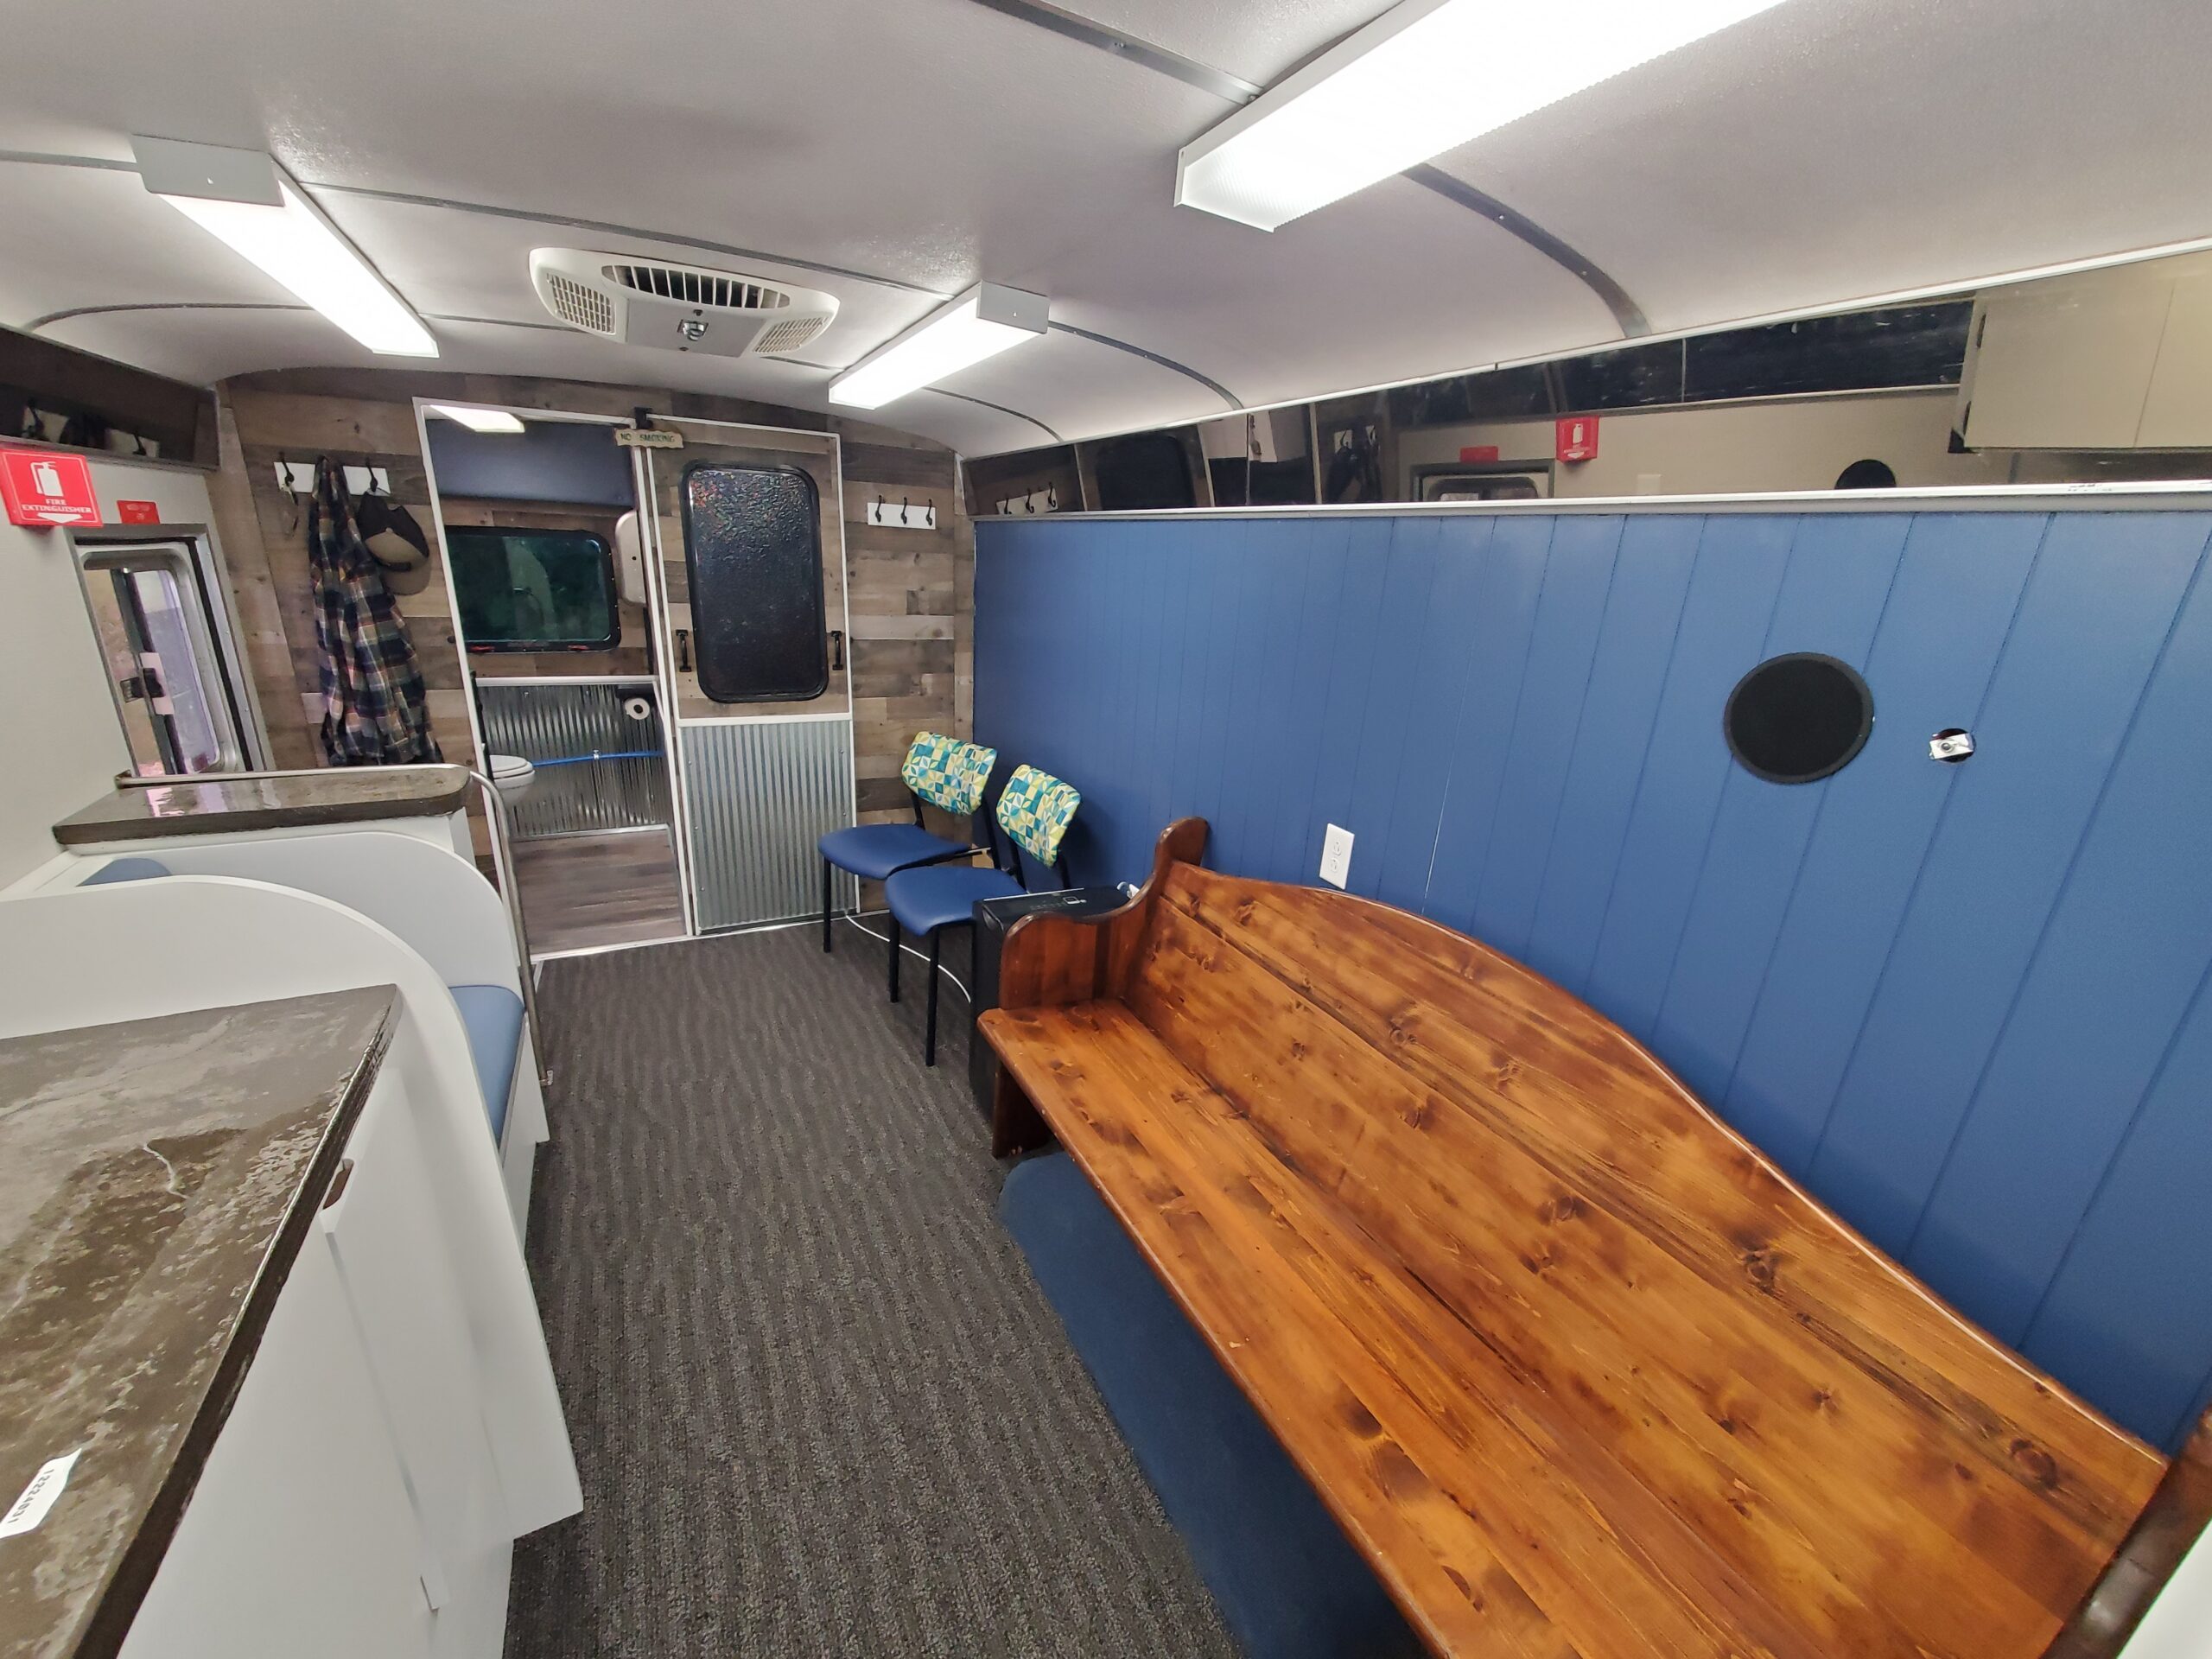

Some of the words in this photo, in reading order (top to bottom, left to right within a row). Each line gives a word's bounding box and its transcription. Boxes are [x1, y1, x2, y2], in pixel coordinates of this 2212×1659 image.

[620, 433, 632, 442] NO
[640, 434, 675, 443] SMOKING
[22, 504, 92, 513] EXTINGUISHER
